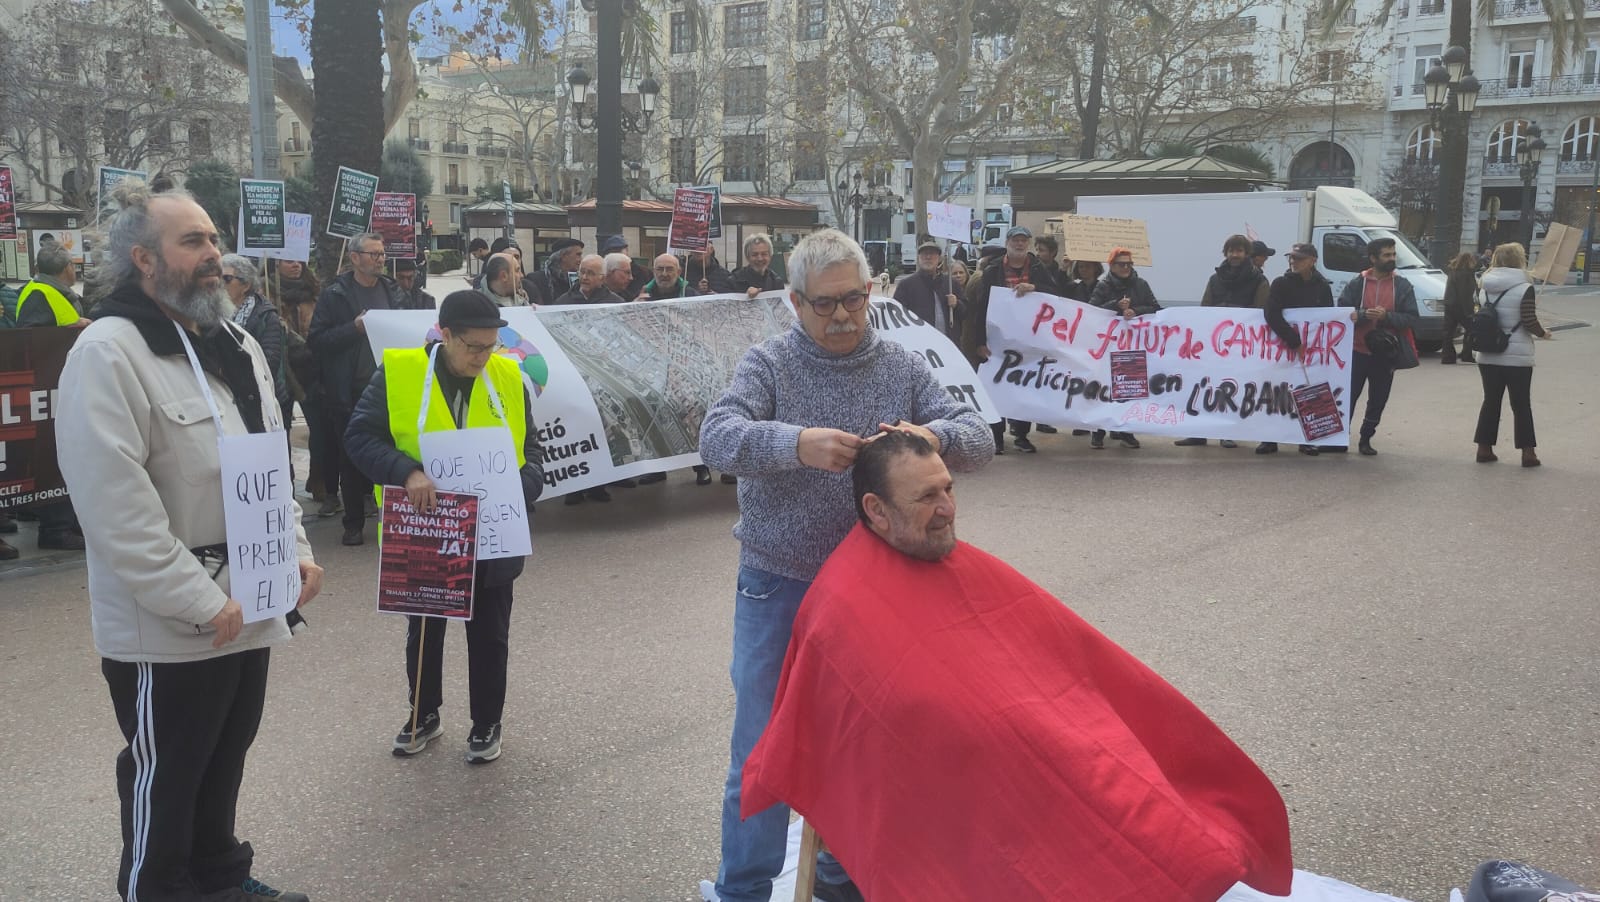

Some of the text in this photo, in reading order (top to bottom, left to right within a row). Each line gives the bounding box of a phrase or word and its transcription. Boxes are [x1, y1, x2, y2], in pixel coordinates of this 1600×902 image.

[245, 185, 280, 193] DEFENSEM
[251, 215, 277, 225] BARRI
[340, 203, 365, 217] BARRI
[398, 216, 413, 226] JA!
[1032, 303, 1083, 345] Pel
[1088, 315, 1180, 360] futur
[1178, 327, 1204, 360] de
[993, 350, 1130, 410] Participac
[1149, 373, 1183, 396] en
[536, 417, 566, 442] ció
[541, 433, 599, 464] ltural
[431, 451, 507, 478] QUE NO
[543, 461, 590, 487] ques
[11, 494, 33, 506] TRES
[35, 487, 70, 501] FORQU
[236, 469, 279, 504] QUE
[392, 503, 469, 518] PARCPACIÓ
[402, 496, 460, 507] AMENT:
[480, 499, 521, 524] GUEN
[266, 503, 294, 535] ENS
[401, 513, 459, 529] VEÏNAL EN
[389, 524, 468, 541] L'URBANISME,
[437, 540, 469, 557] JA!
[256, 580, 276, 612] EL
